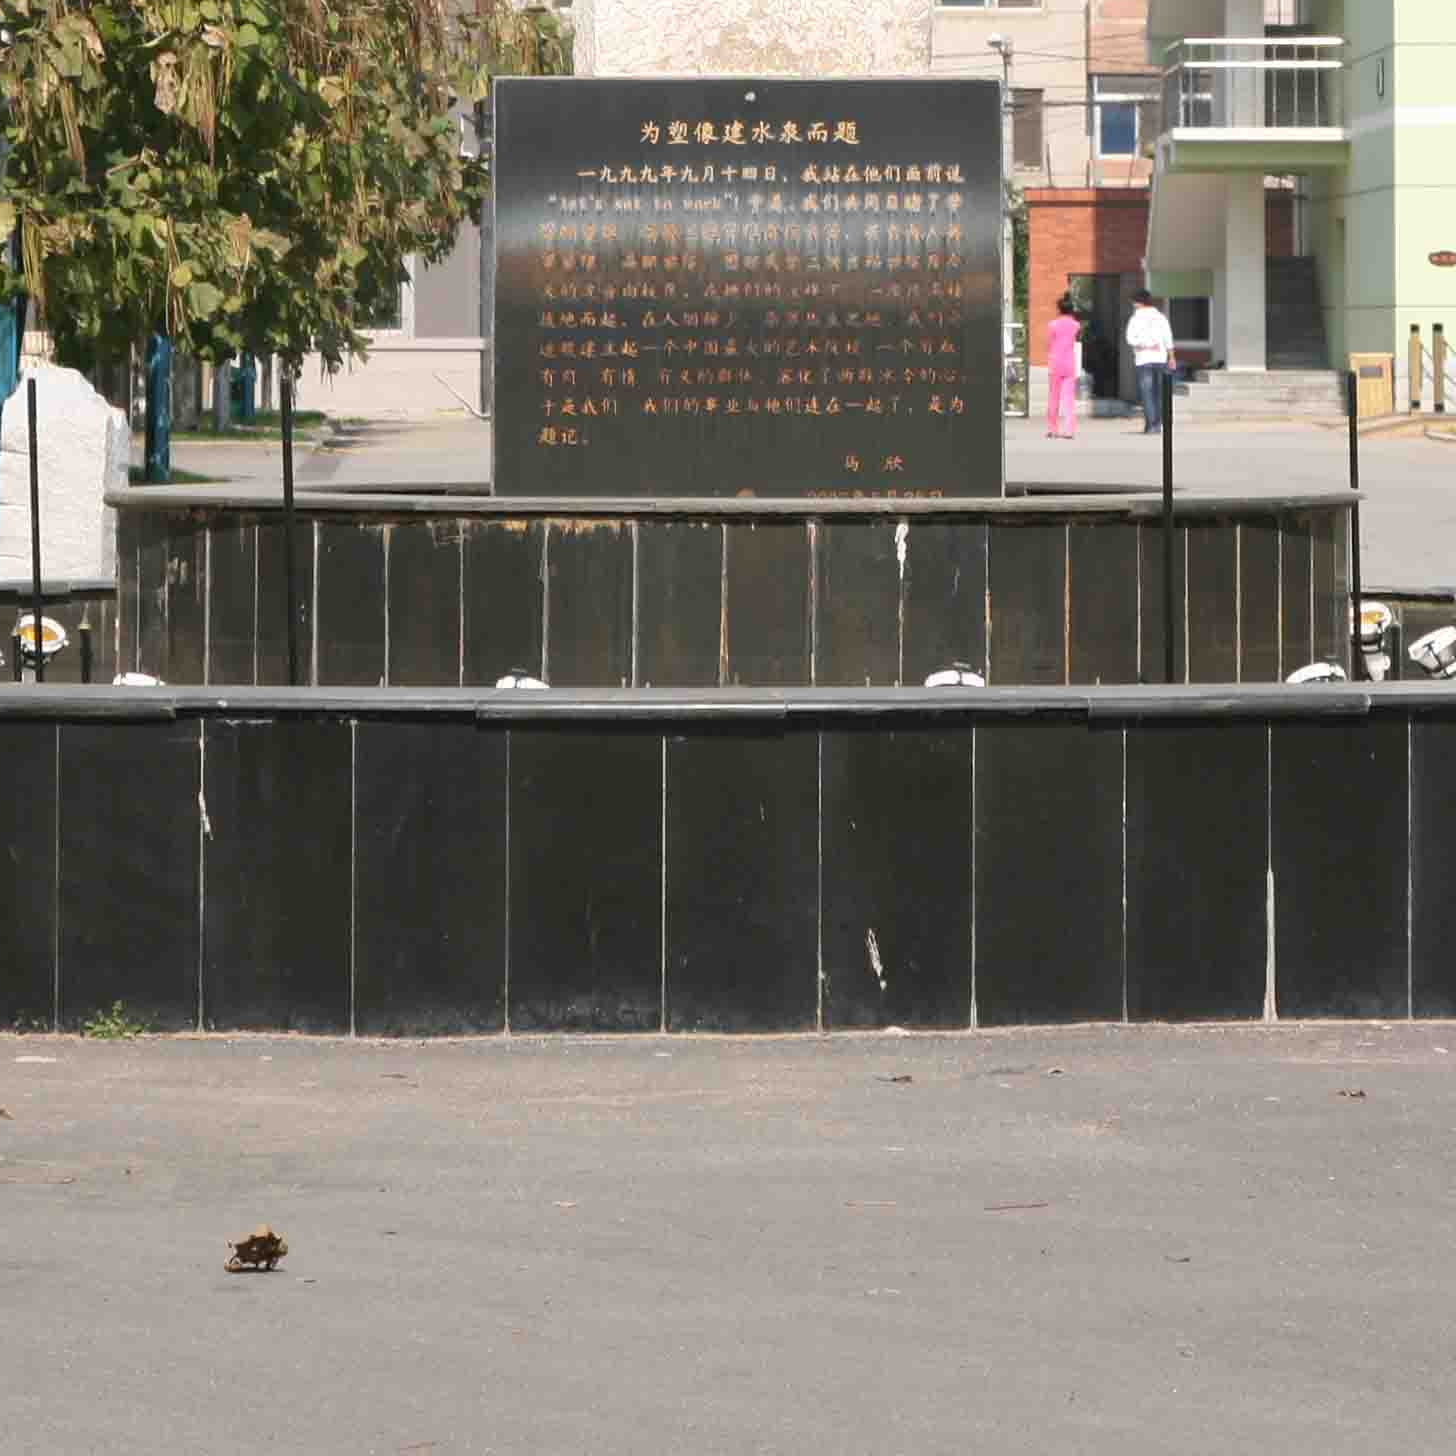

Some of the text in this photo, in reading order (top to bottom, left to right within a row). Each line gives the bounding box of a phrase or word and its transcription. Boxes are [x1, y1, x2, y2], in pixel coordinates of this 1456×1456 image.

[640, 120, 861, 146] 为塑像建水泉而题
